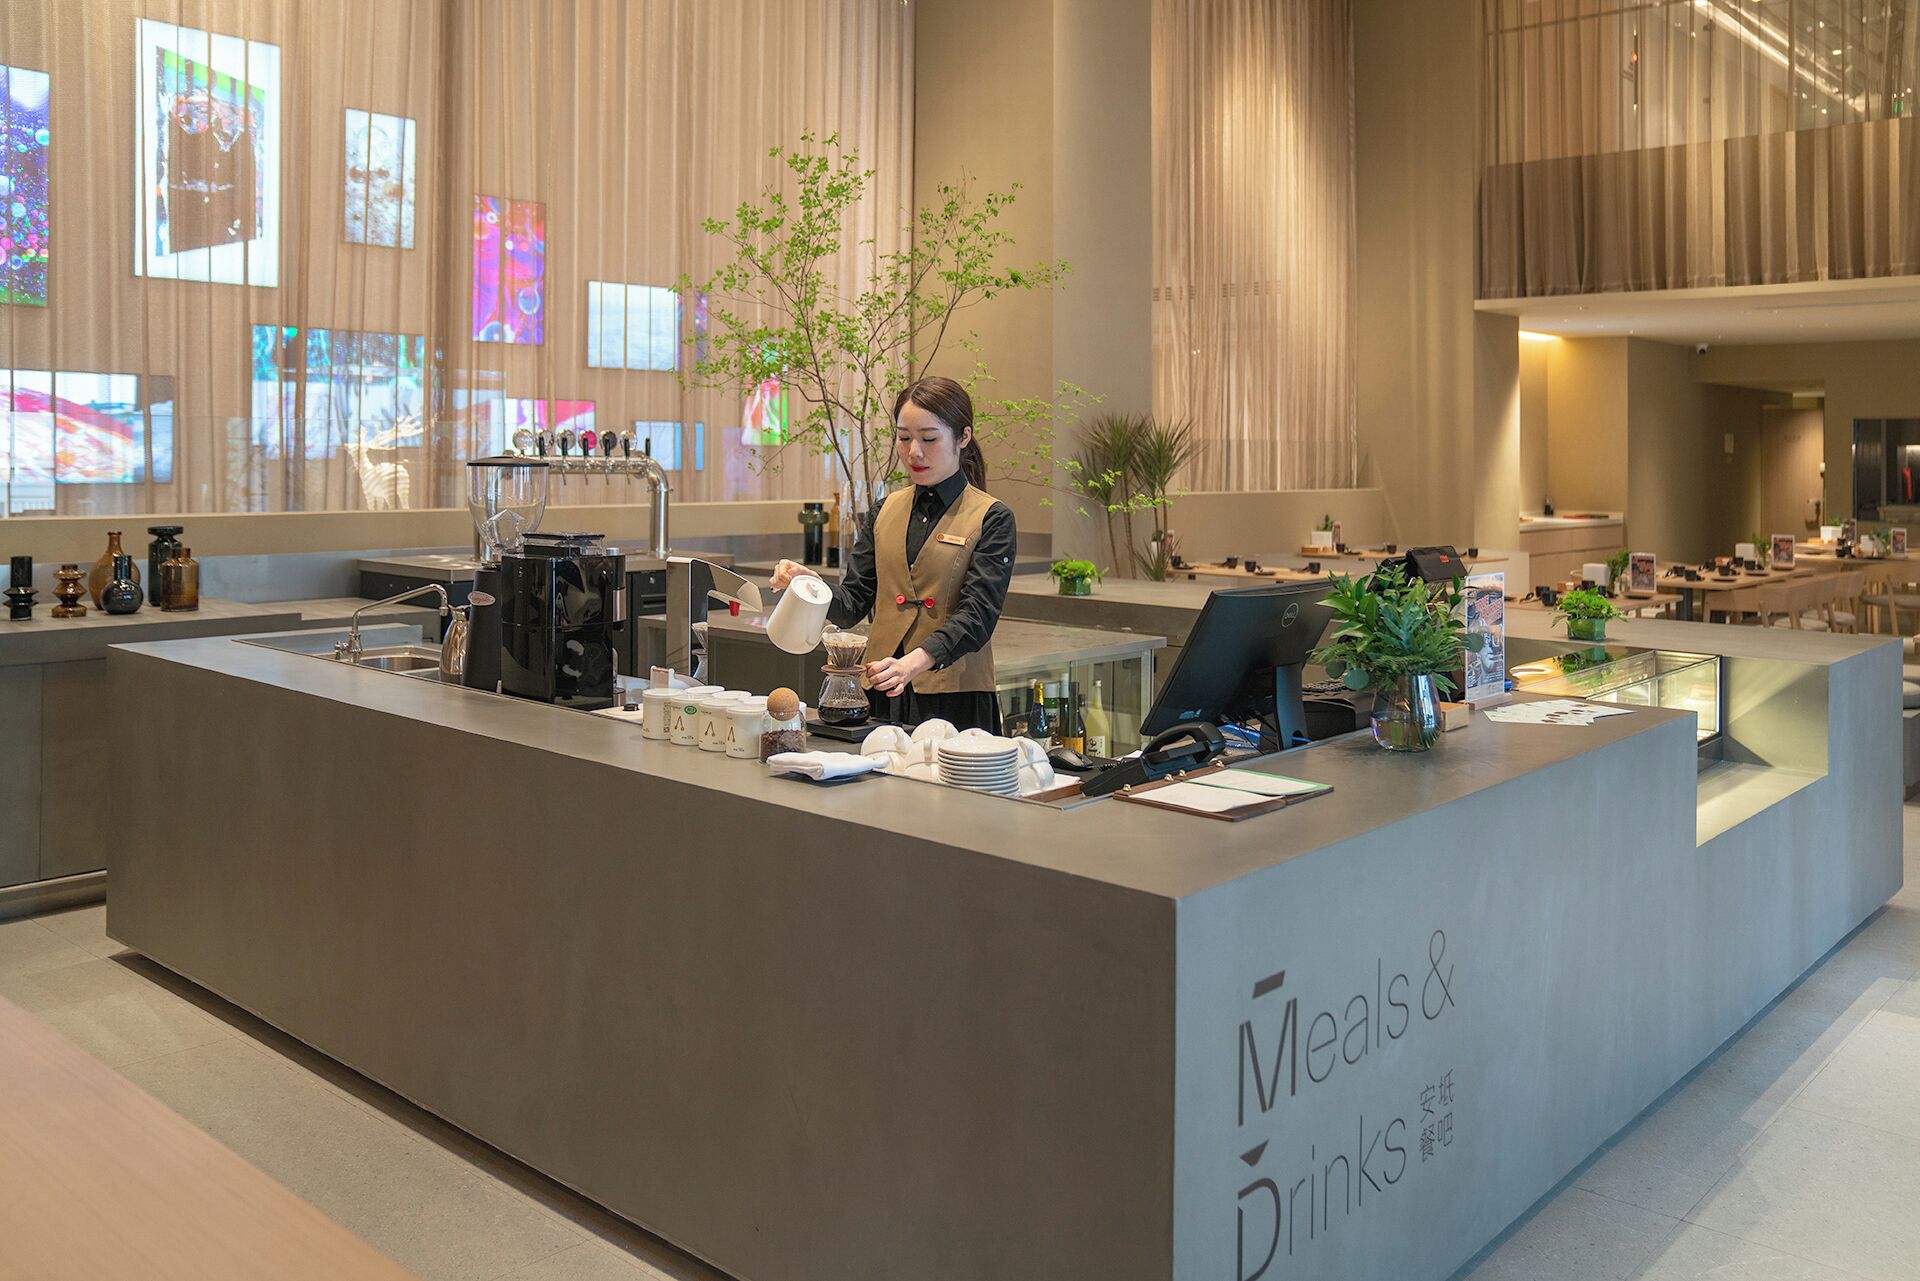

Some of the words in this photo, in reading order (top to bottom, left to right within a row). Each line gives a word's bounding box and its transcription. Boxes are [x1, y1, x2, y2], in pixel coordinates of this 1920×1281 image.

[1238, 957, 1410, 1127] Meals
[1421, 929, 1455, 1020] &
[1237, 1114, 1407, 1281] Drinks
